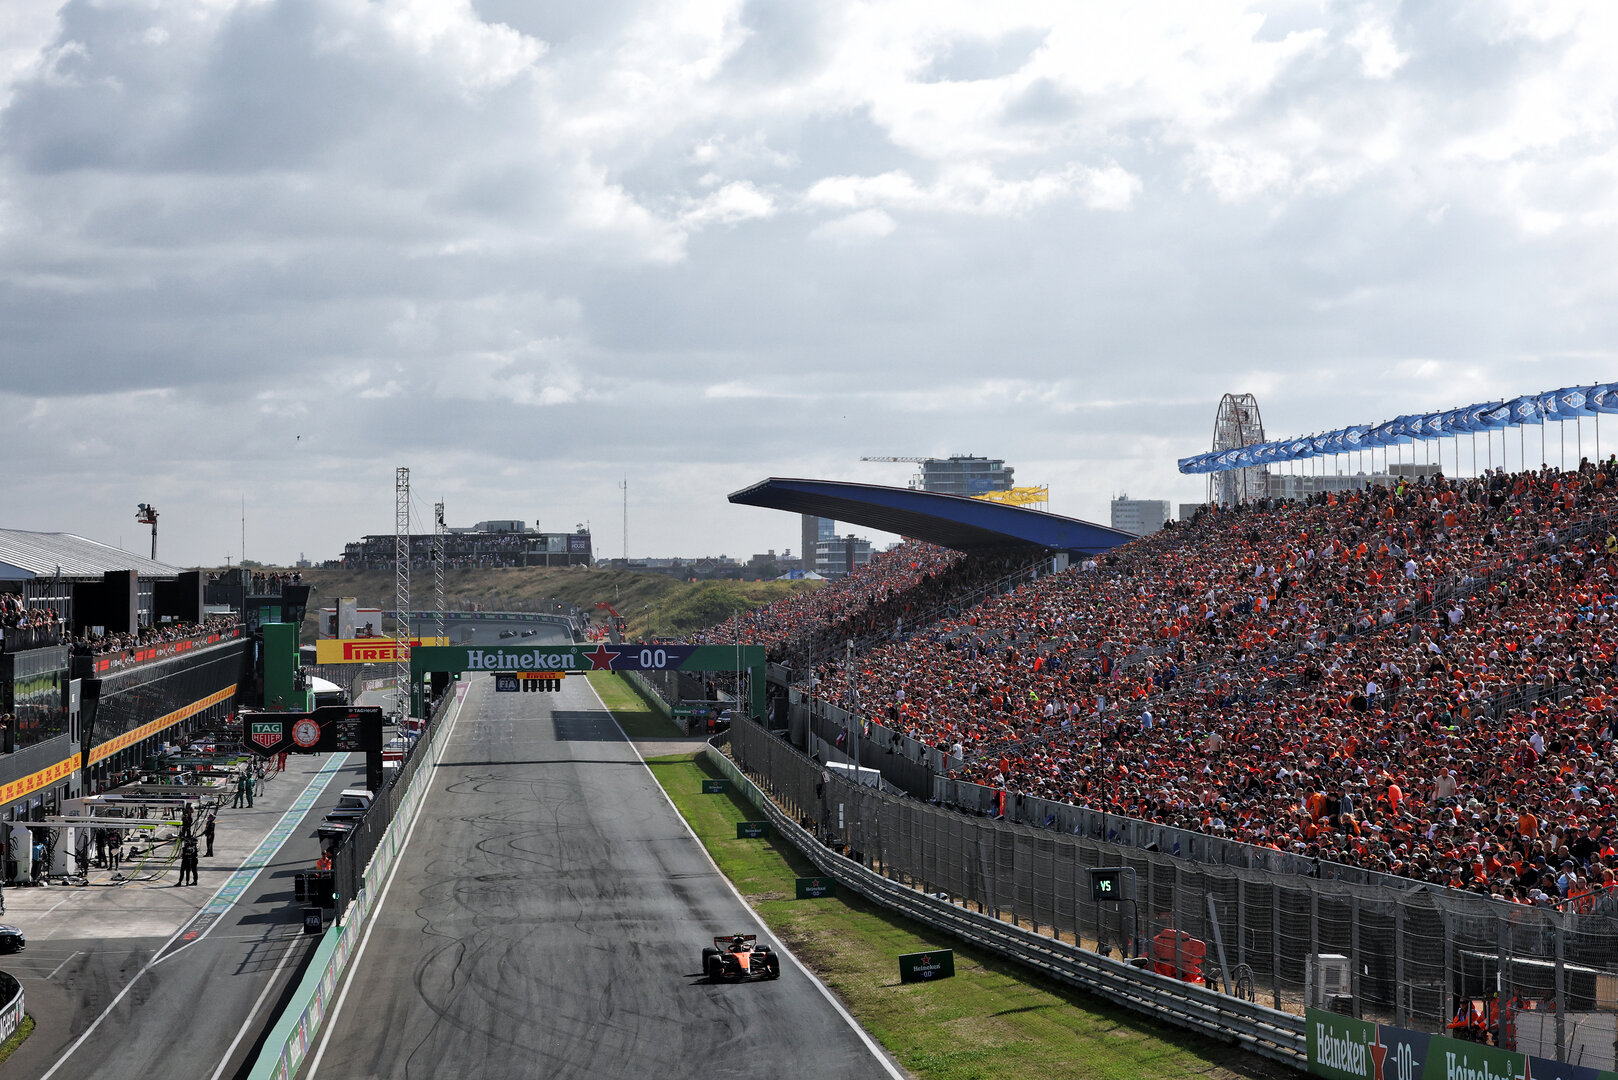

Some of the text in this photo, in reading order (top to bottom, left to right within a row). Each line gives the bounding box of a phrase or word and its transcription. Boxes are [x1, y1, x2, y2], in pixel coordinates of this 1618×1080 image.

[467, 649, 666, 669] Heineken 0.0
[499, 680, 517, 688] FIA
[254, 724, 280, 733] TAG
[253, 733, 281, 748] HEUER
[305, 916, 320, 925] FIA
[913, 963, 941, 972] Heineken
[1316, 1022, 1367, 1077] Heineken
